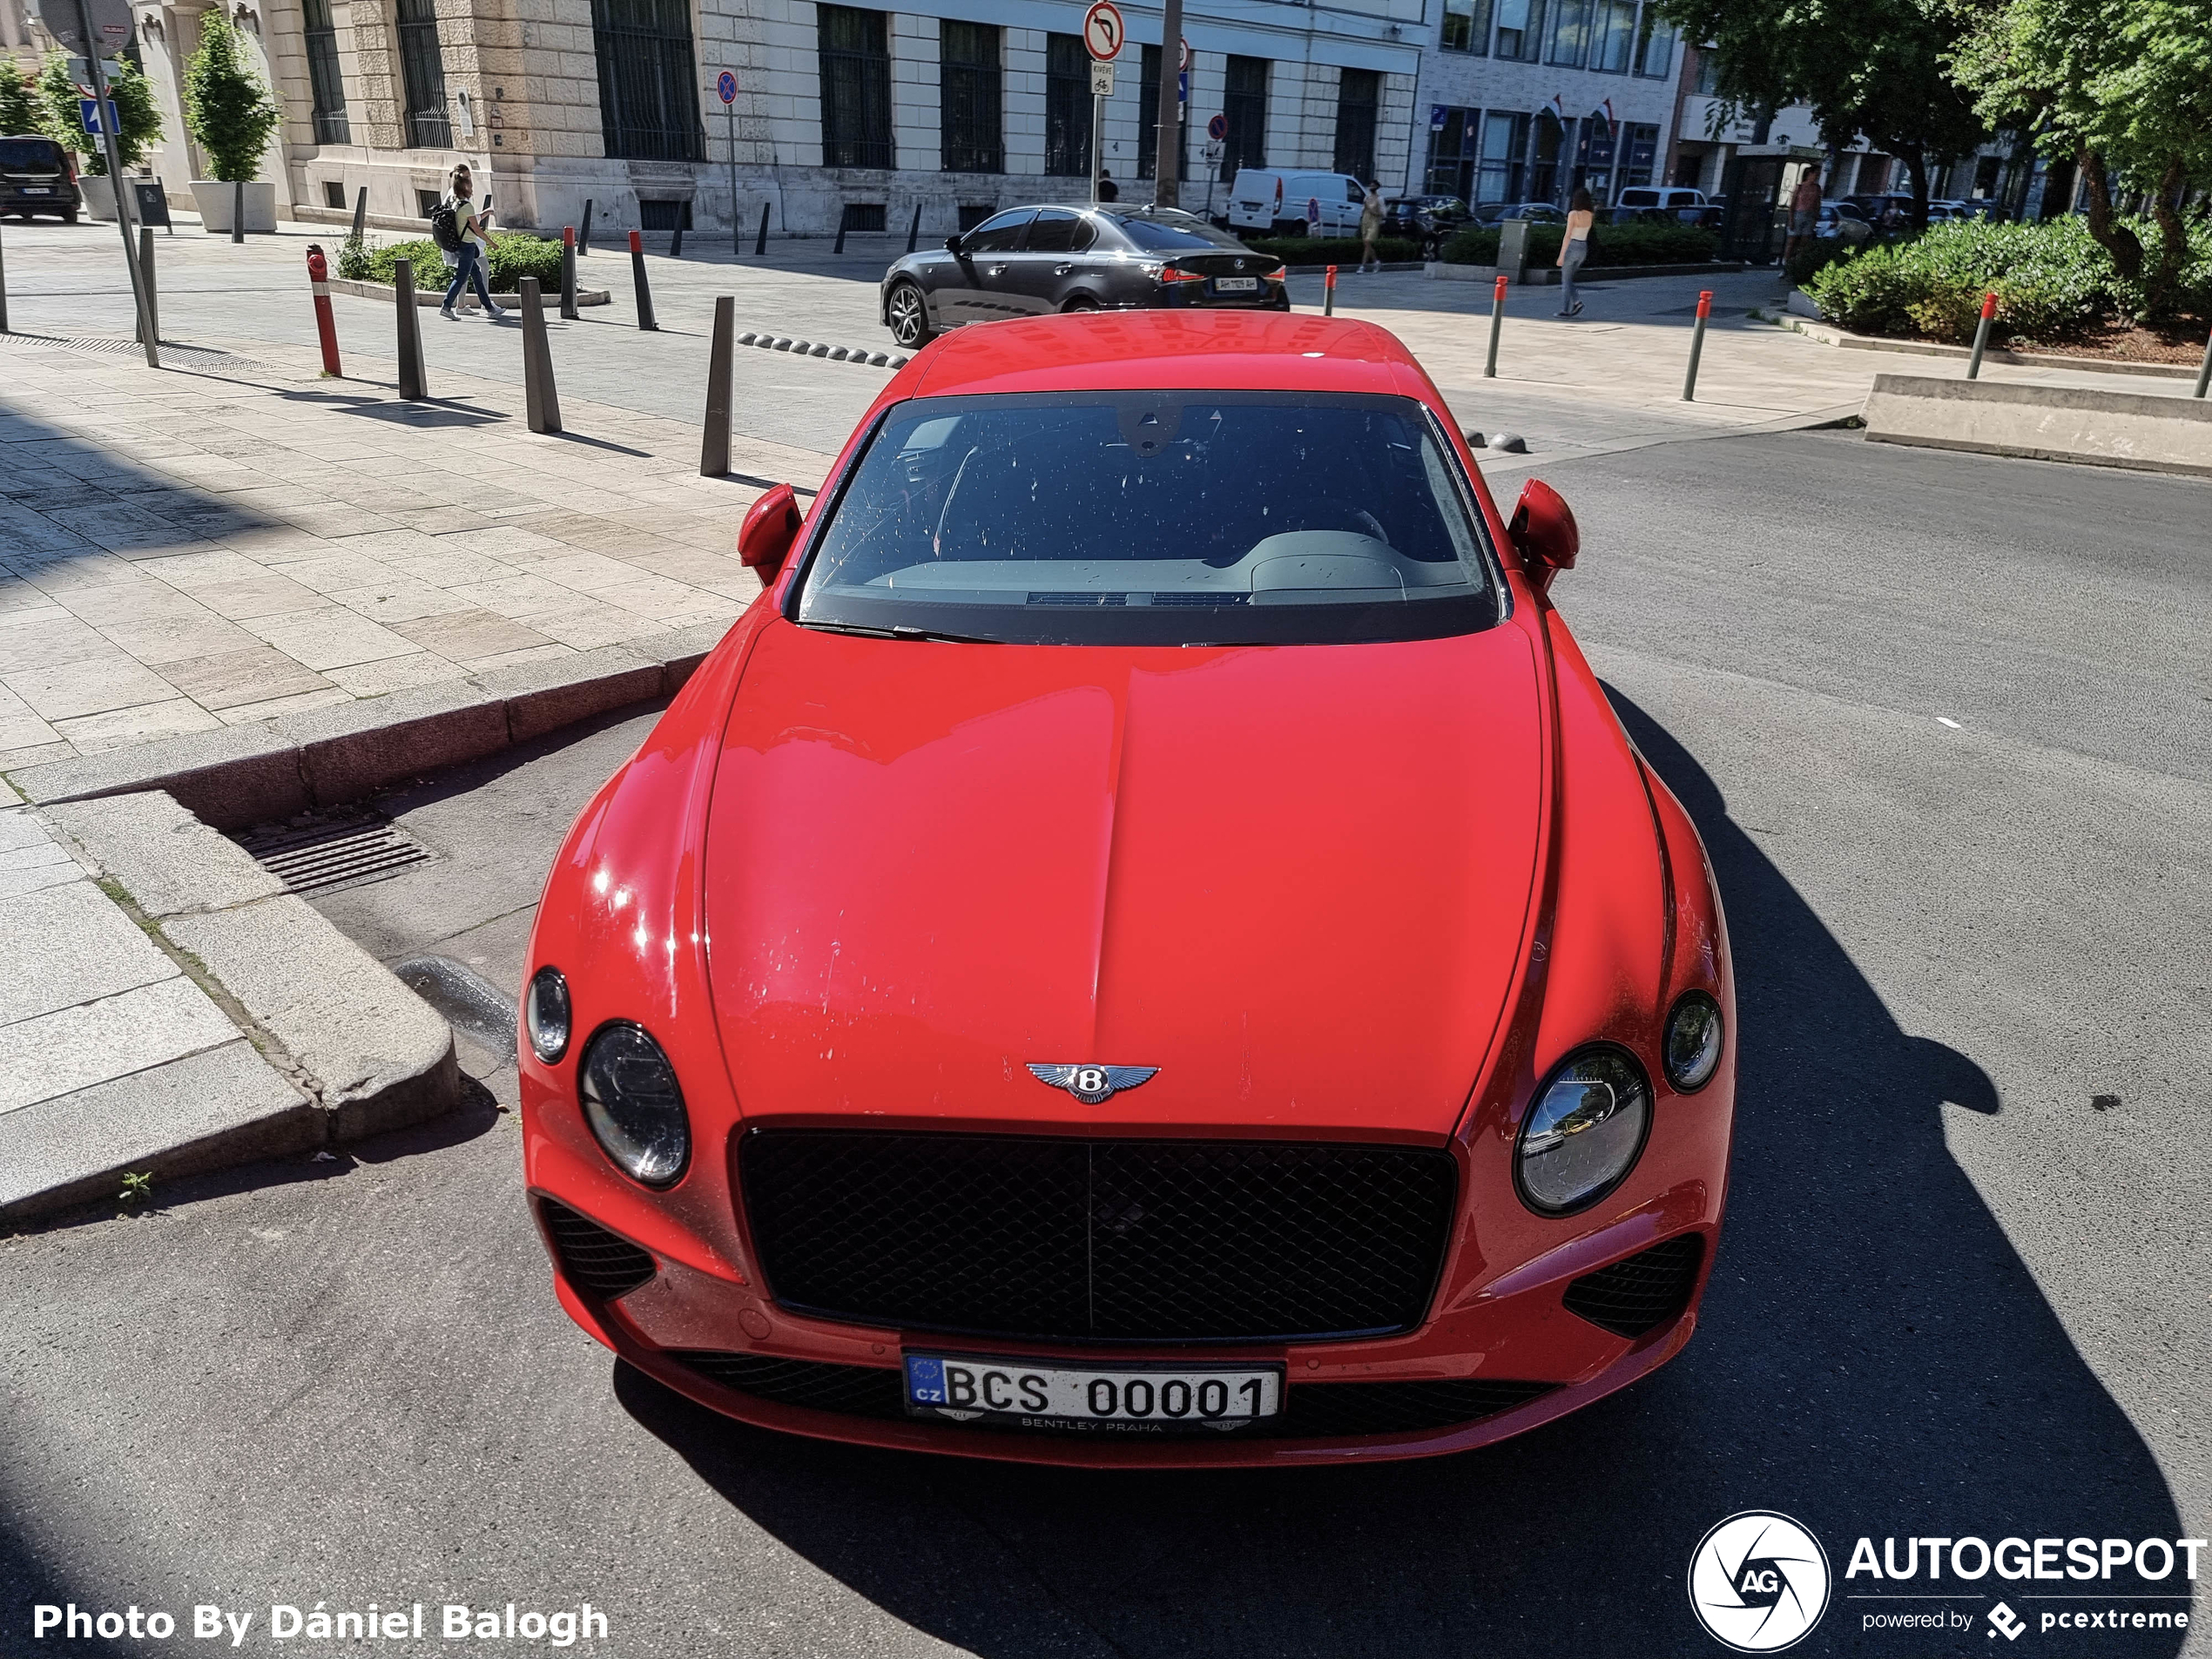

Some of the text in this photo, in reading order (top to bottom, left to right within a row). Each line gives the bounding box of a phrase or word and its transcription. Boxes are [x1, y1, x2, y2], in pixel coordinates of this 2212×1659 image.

[916, 1388, 941, 1402] CZ
[945, 1366, 1263, 1418] BCS 00001
[1022, 1418, 1163, 1432] BENTLEY PRAHA
